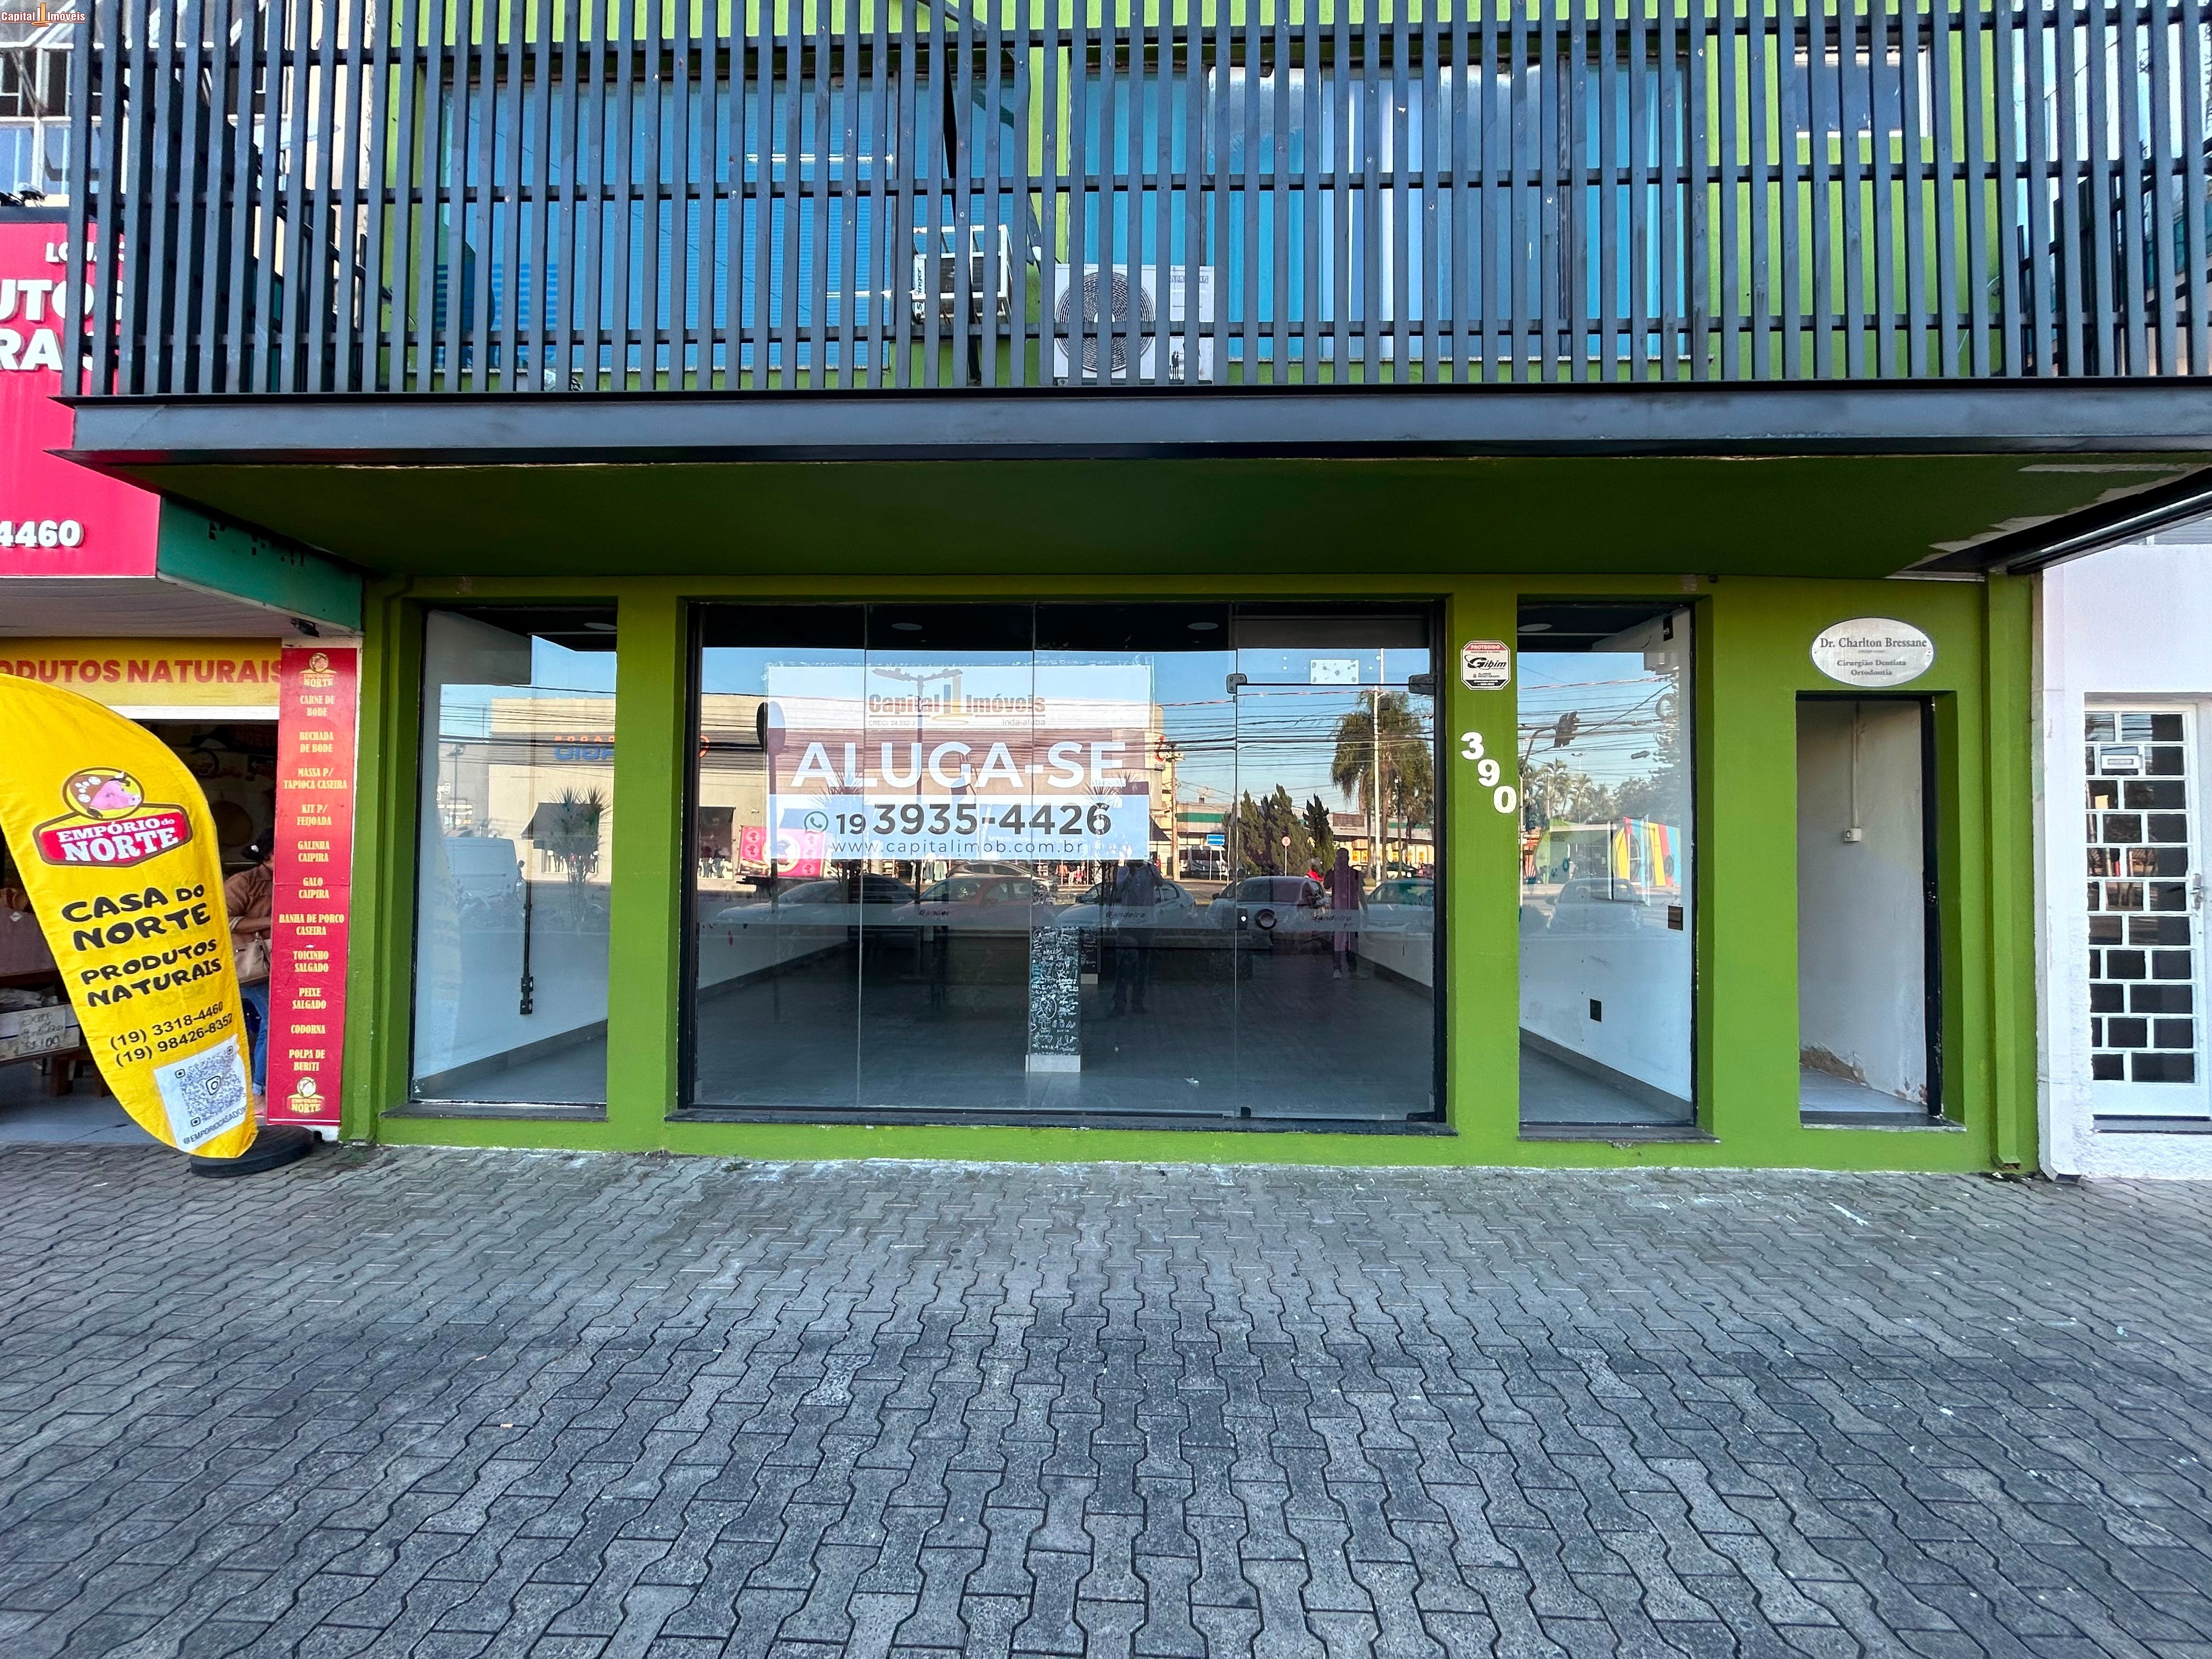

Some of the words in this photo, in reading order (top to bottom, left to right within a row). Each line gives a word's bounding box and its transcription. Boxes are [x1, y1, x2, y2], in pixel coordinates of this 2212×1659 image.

[1821, 638, 1835, 647] Dr.
[1838, 637, 1882, 647] Charlton
[1884, 637, 1927, 647] Bressane
[1467, 657, 1506, 669] Gibim
[1837, 659, 1873, 668] Cirurgião
[303, 678, 334, 687] NORTE
[300, 695, 324, 704] CARNE
[325, 695, 335, 704] DE
[869, 694, 940, 714] Capital
[966, 693, 1046, 713] Imóveis
[307, 707, 328, 716] BODE
[299, 731, 334, 741] BUCHADA
[300, 744, 310, 753] DE
[312, 744, 333, 753] BODE
[790, 742, 1127, 788] ALUGA-SE
[298, 768, 321, 777] MASSA
[323, 768, 334, 777] P/
[1461, 732, 1517, 813] 390
[283, 780, 315, 789] TAPIOCA
[317, 780, 347, 789] CASEIRA
[302, 804, 315, 814] KIT
[317, 804, 329, 814] P/
[297, 816, 332, 826] FEIJOADA
[836, 813, 866, 835] 19
[872, 803, 1111, 835] 3935-4426
[57, 818, 160, 842] EMPÓRIO
[61, 827, 178, 861] NORTE
[297, 840, 330, 850] GALINHA
[832, 839, 1084, 855] www.capitalimob.com.br
[298, 853, 329, 862] CAIPIRA
[303, 877, 323, 887] GALO
[298, 889, 329, 899] CAIPIRA
[62, 887, 168, 922] CASA
[176, 884, 204, 901] DO
[279, 913, 304, 923] BANHA
[306, 913, 317, 923] DE
[319, 913, 345, 923] PORCO
[73, 902, 211, 951] NORTE
[296, 926, 326, 935] CASEIRA
[292, 950, 329, 960] TOICINHO
[81, 939, 217, 985] PRODUTOS
[295, 963, 329, 972] SALGADO
[87, 958, 222, 1007] NATURAIS
[299, 988, 321, 997] PEIXE
[292, 1000, 326, 1009] SALGADO
[110, 1029, 146, 1051] (19)
[152, 1001, 223, 1036] 3318-4460
[291, 1024, 326, 1034] CODORNA
[116, 1046, 153, 1067] (19)
[157, 1013, 233, 1052] 98426-8352
[289, 1049, 313, 1059] POLPA
[315, 1049, 325, 1059] DE
[291, 1103, 321, 1113] NORTE
